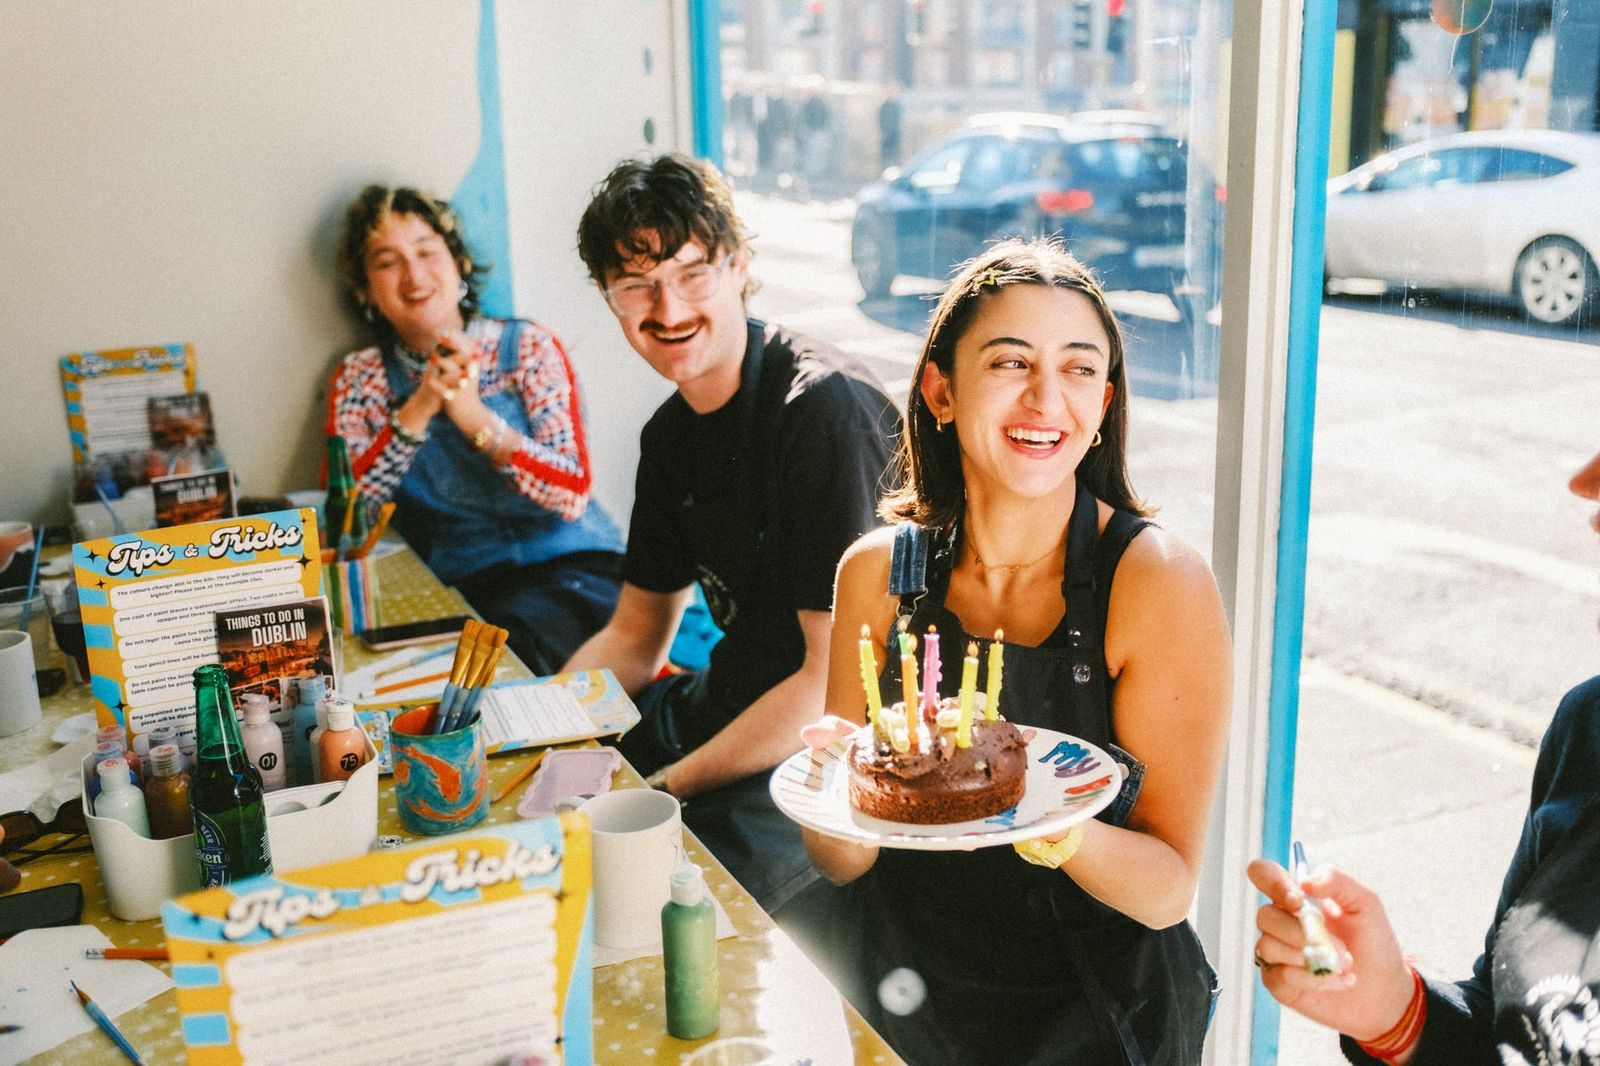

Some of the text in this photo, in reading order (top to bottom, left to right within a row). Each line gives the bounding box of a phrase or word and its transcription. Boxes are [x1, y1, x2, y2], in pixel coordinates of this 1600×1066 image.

[106, 521, 303, 577] Tips & Tricks
[152, 583, 173, 591] change
[225, 607, 305, 631] THINGS TO DO IN
[252, 621, 307, 648] DUBLIN
[144, 708, 173, 718] unpainted
[176, 712, 196, 720] dipped
[261, 754, 275, 768] 01
[340, 754, 357, 769] 75
[200, 824, 214, 844] BEER
[223, 888, 340, 940] Tips
[401, 842, 562, 903] Tricks
